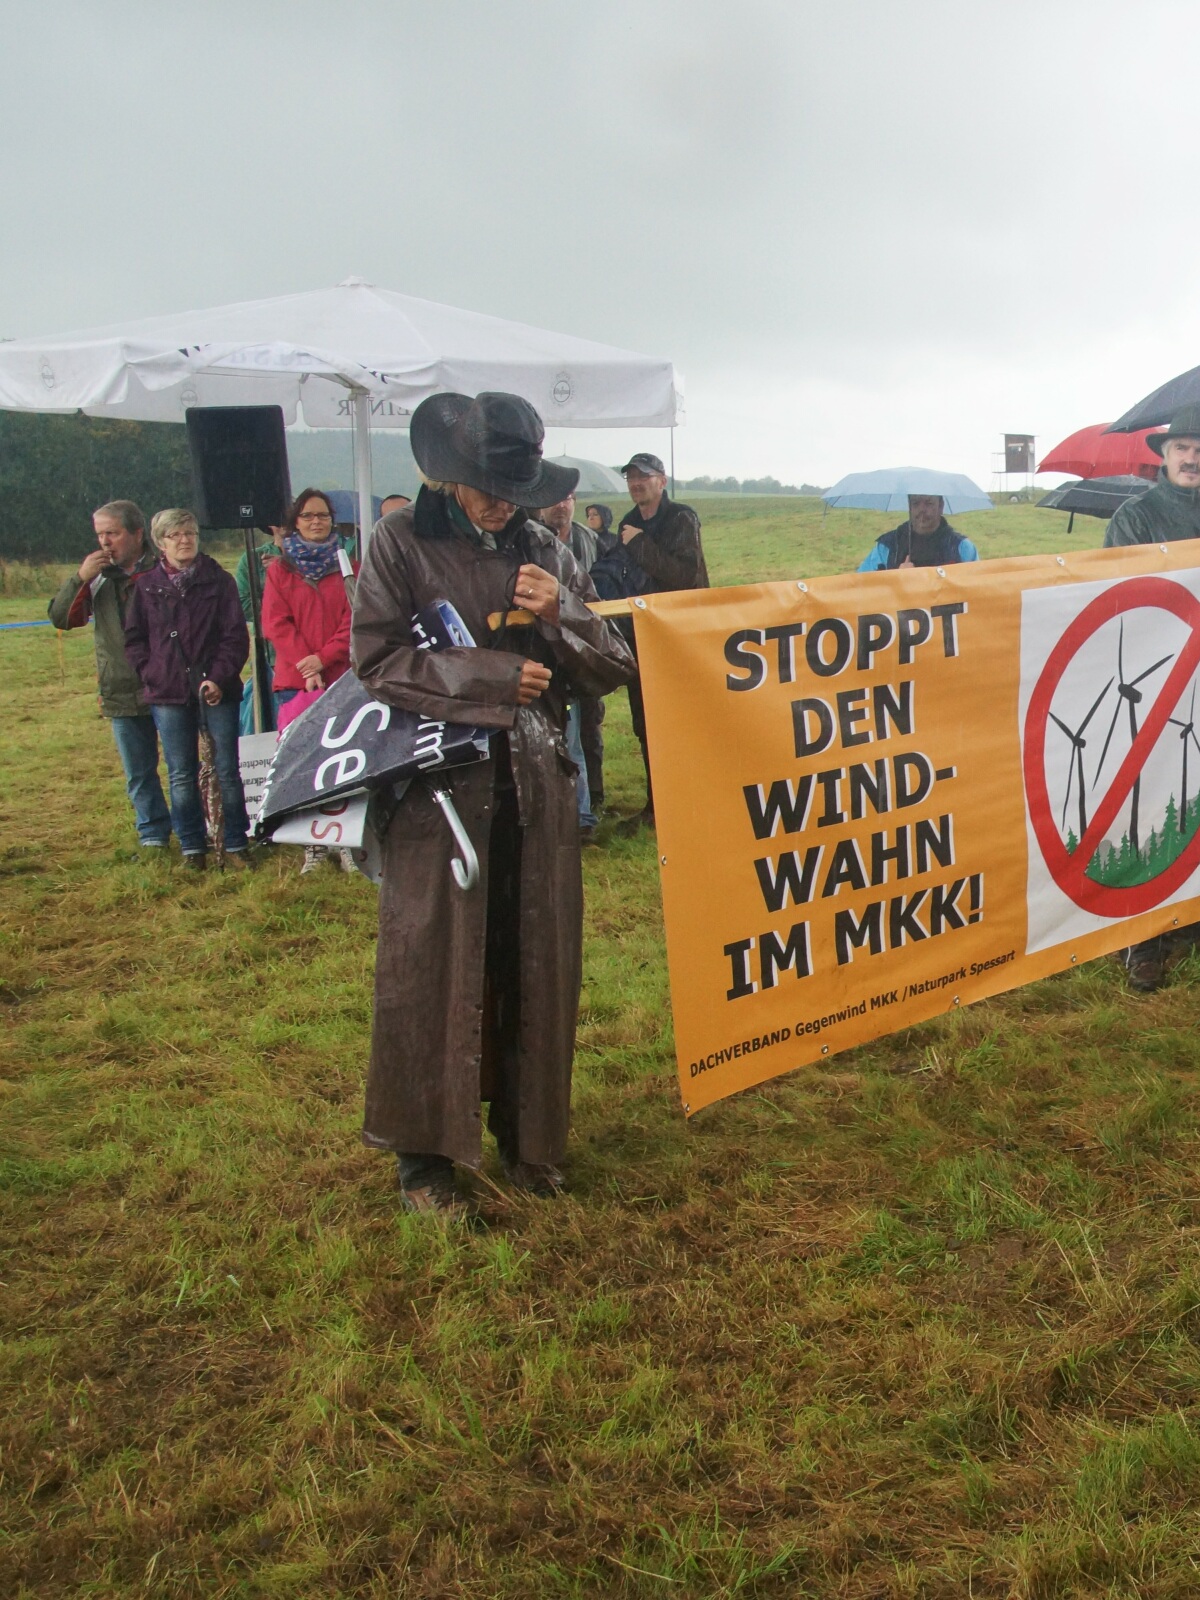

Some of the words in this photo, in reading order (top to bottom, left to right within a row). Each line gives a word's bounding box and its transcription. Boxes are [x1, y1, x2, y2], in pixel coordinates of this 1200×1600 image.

[724, 602, 968, 691] STOPPT
[791, 680, 915, 758] DEN
[743, 752, 957, 840] WIND-
[754, 813, 955, 913] WAHN
[724, 920, 814, 1001] IM
[835, 872, 984, 966] MKK!
[690, 1028, 791, 1078] DACHVERBAND
[795, 1000, 867, 1037] Gegenwind
[870, 990, 899, 1010] MKK
[969, 950, 1015, 975] Spessart
